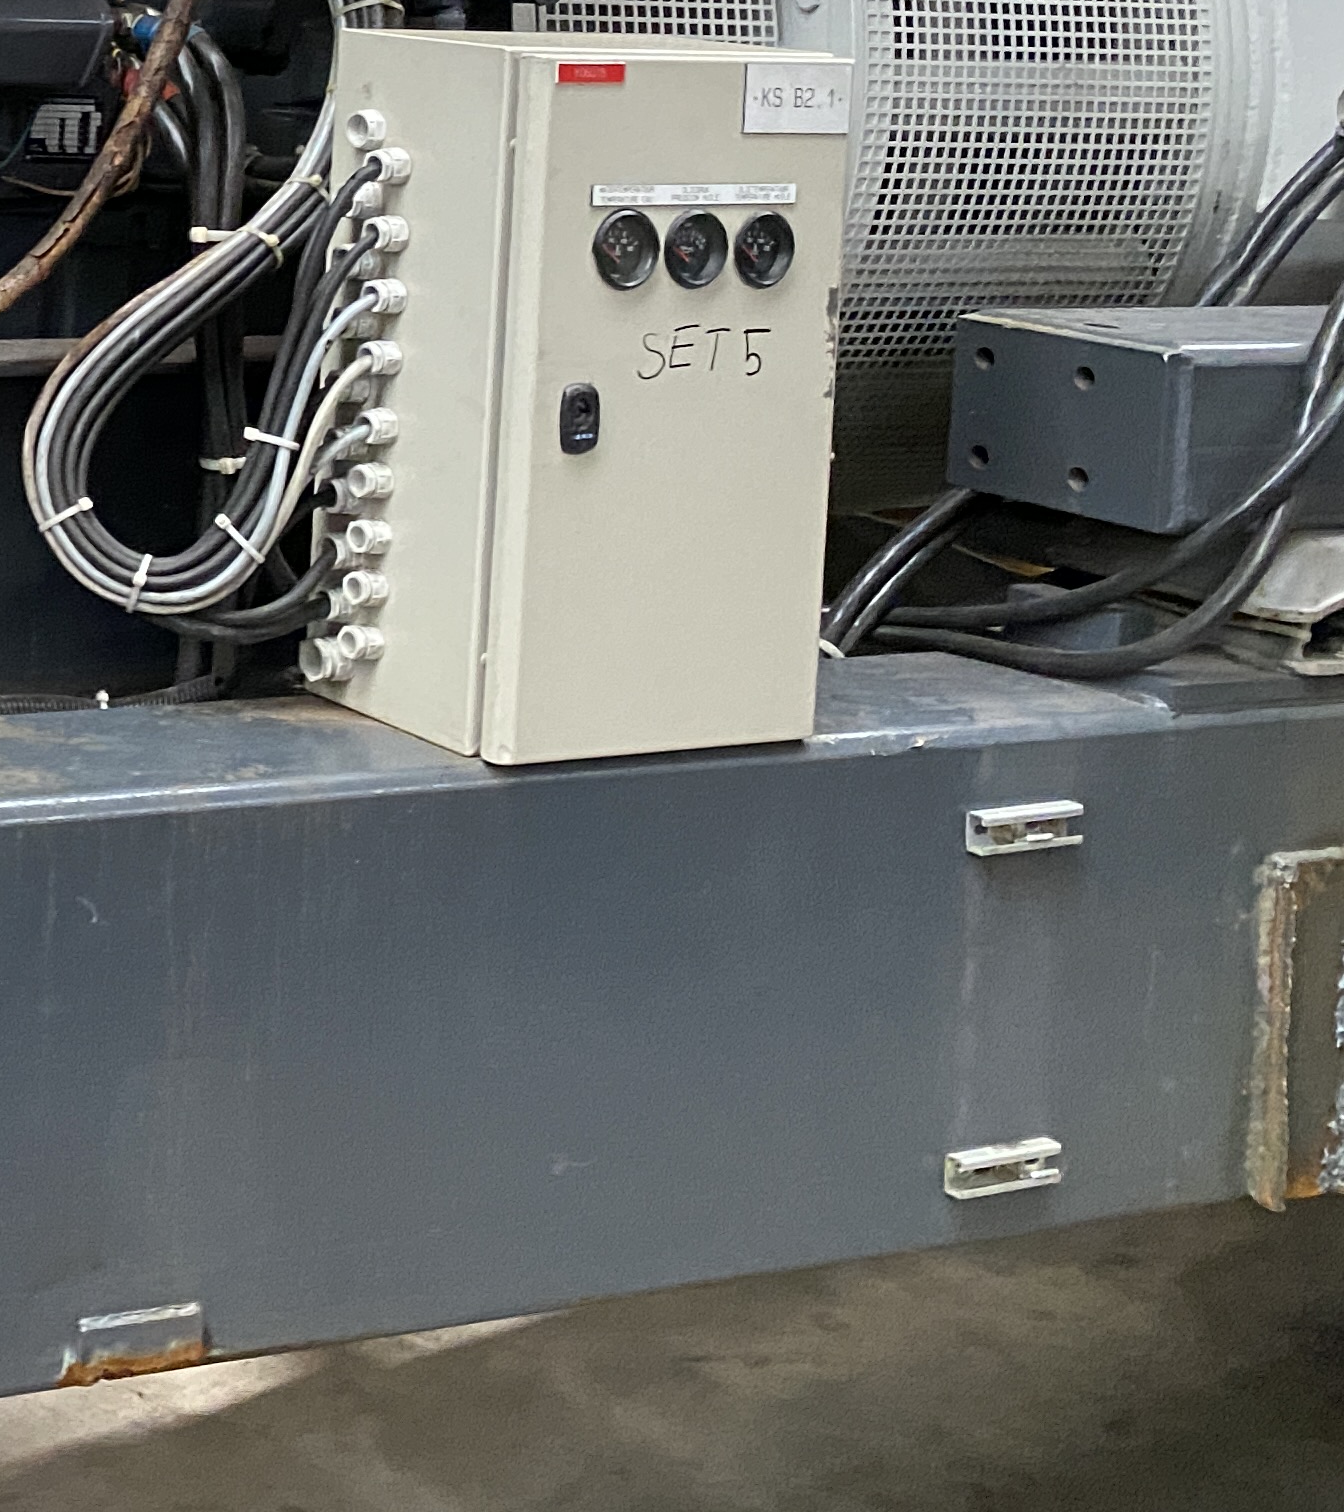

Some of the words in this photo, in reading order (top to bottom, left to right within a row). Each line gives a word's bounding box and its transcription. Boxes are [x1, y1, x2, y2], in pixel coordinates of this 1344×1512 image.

[760, 87, 784, 108] KS
[637, 324, 731, 380] SET
[743, 328, 772, 376] 5
